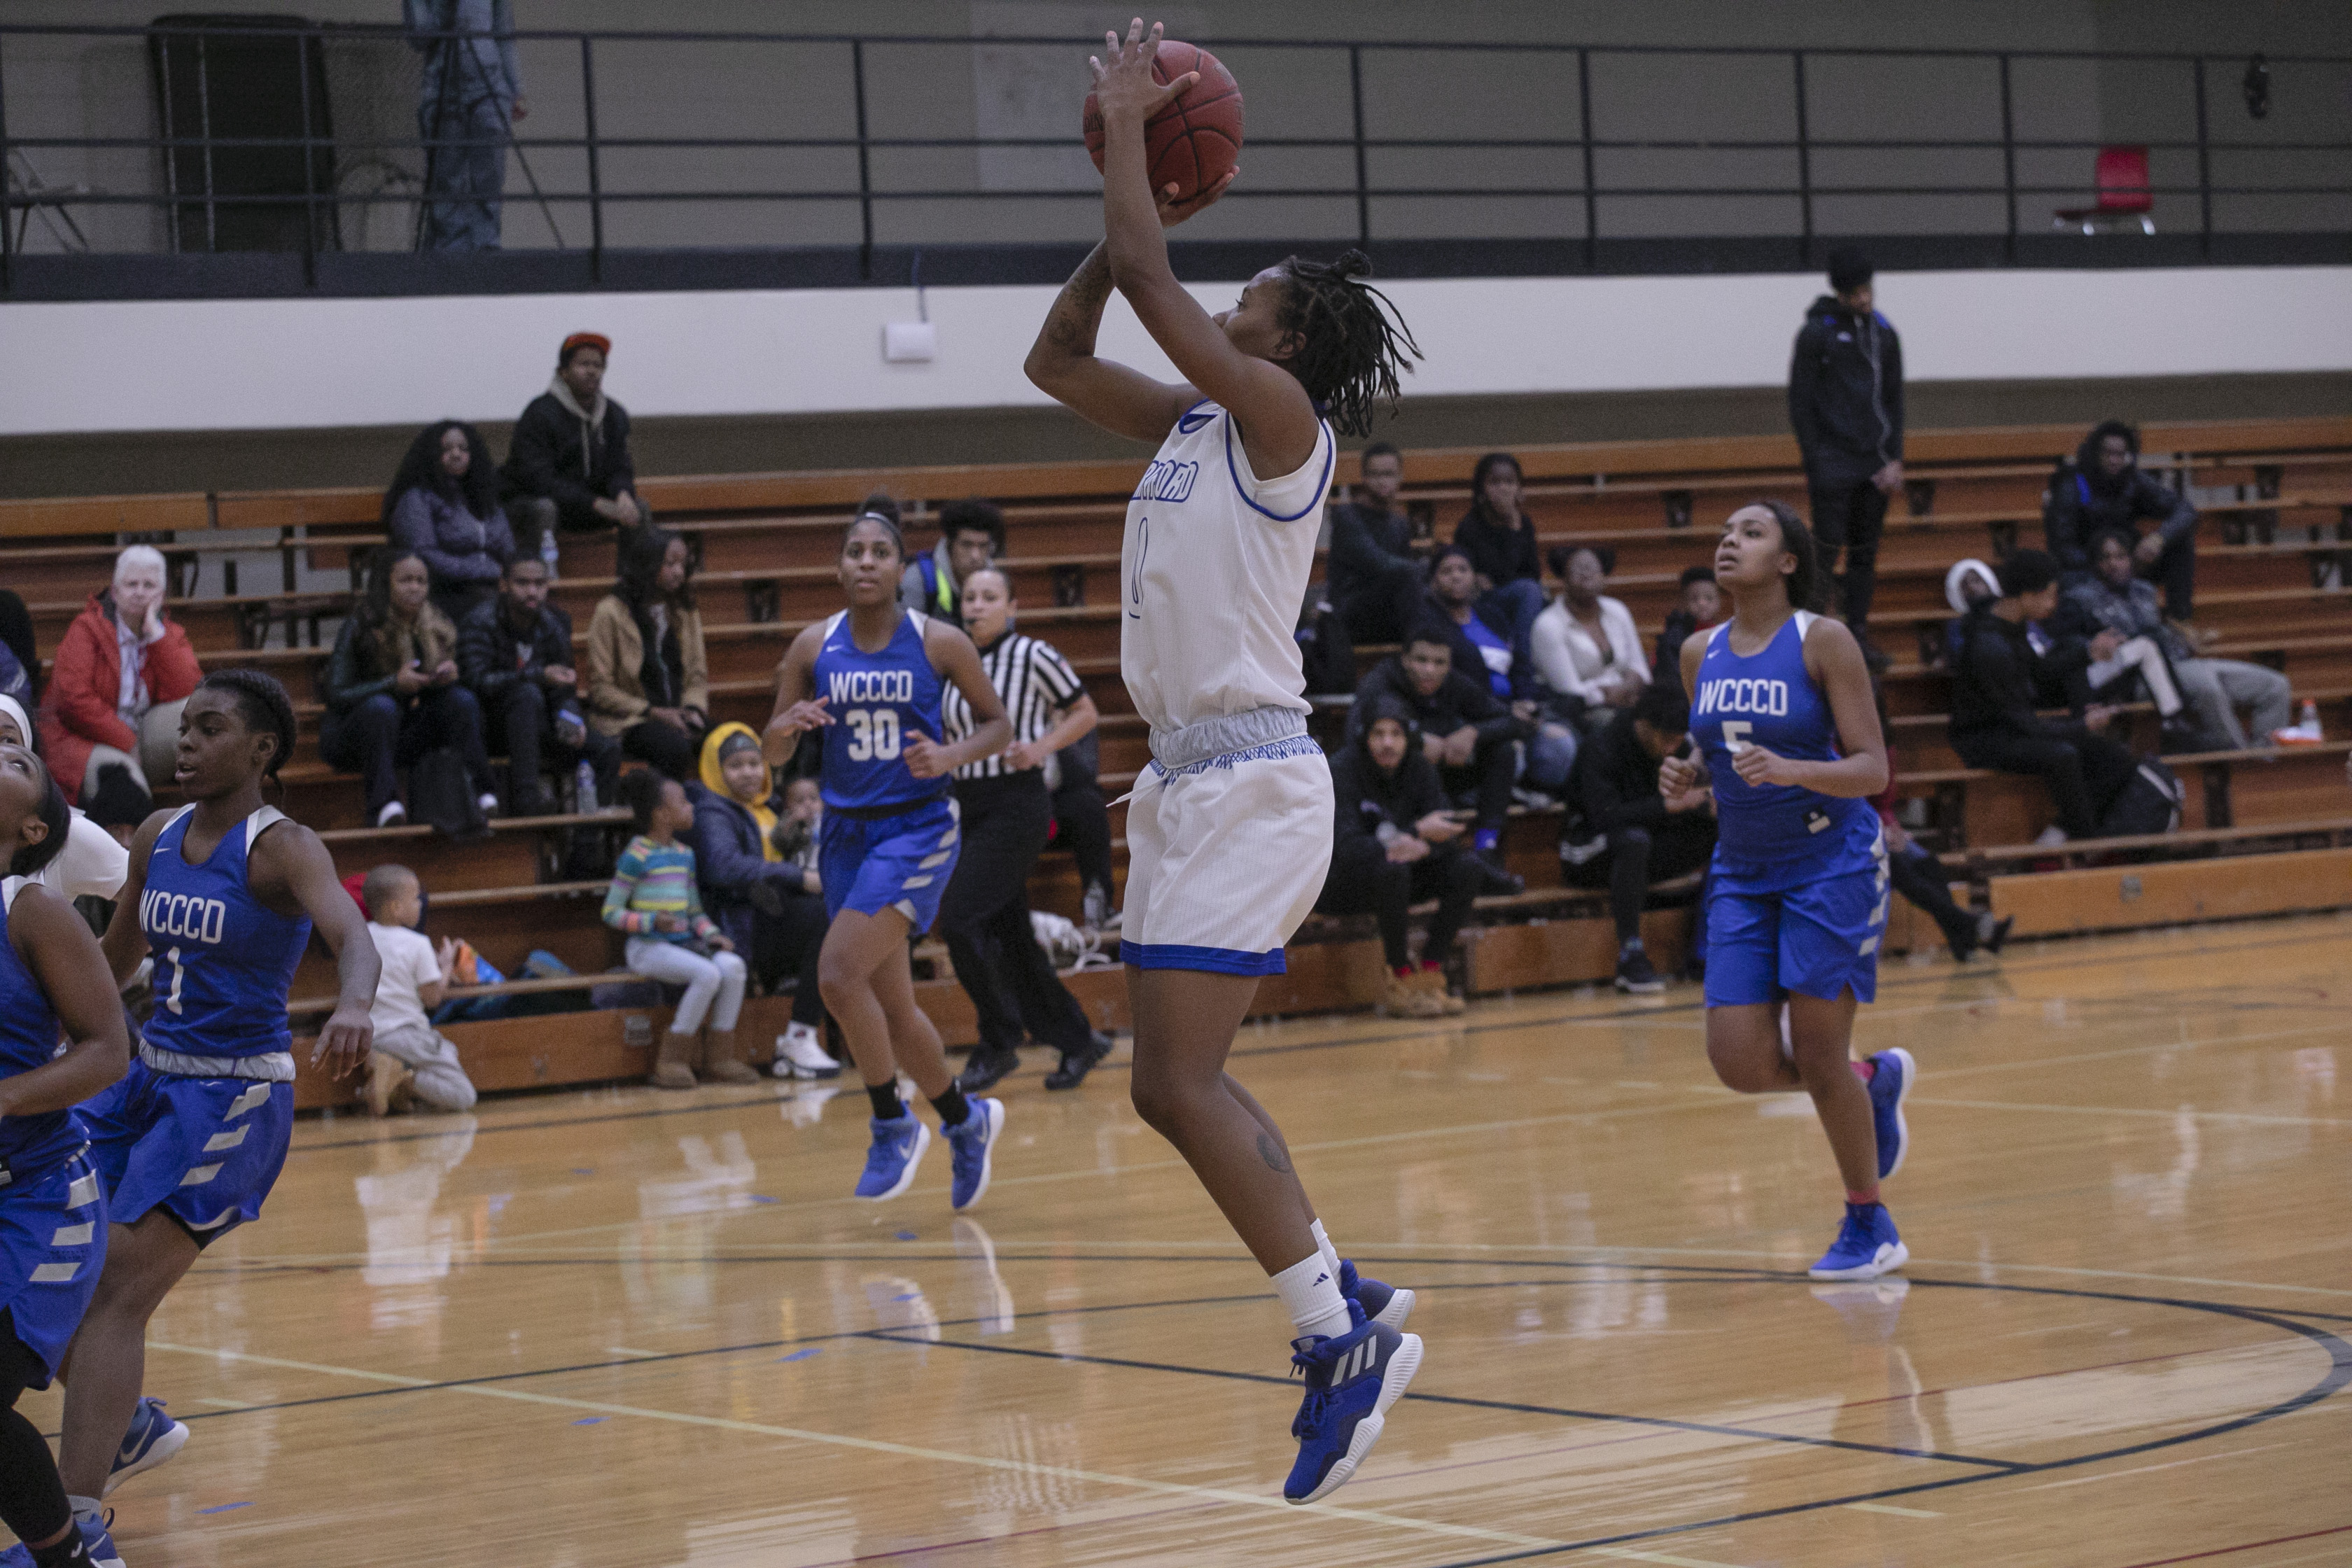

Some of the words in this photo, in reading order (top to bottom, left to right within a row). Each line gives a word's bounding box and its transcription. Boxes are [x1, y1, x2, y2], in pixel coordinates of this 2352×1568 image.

[829, 670, 913, 705] WCCCD
[1698, 678, 1789, 717] WCCCD
[845, 708, 901, 762] 30
[139, 889, 226, 944] WCCCD
[167, 946, 184, 1016] 1
